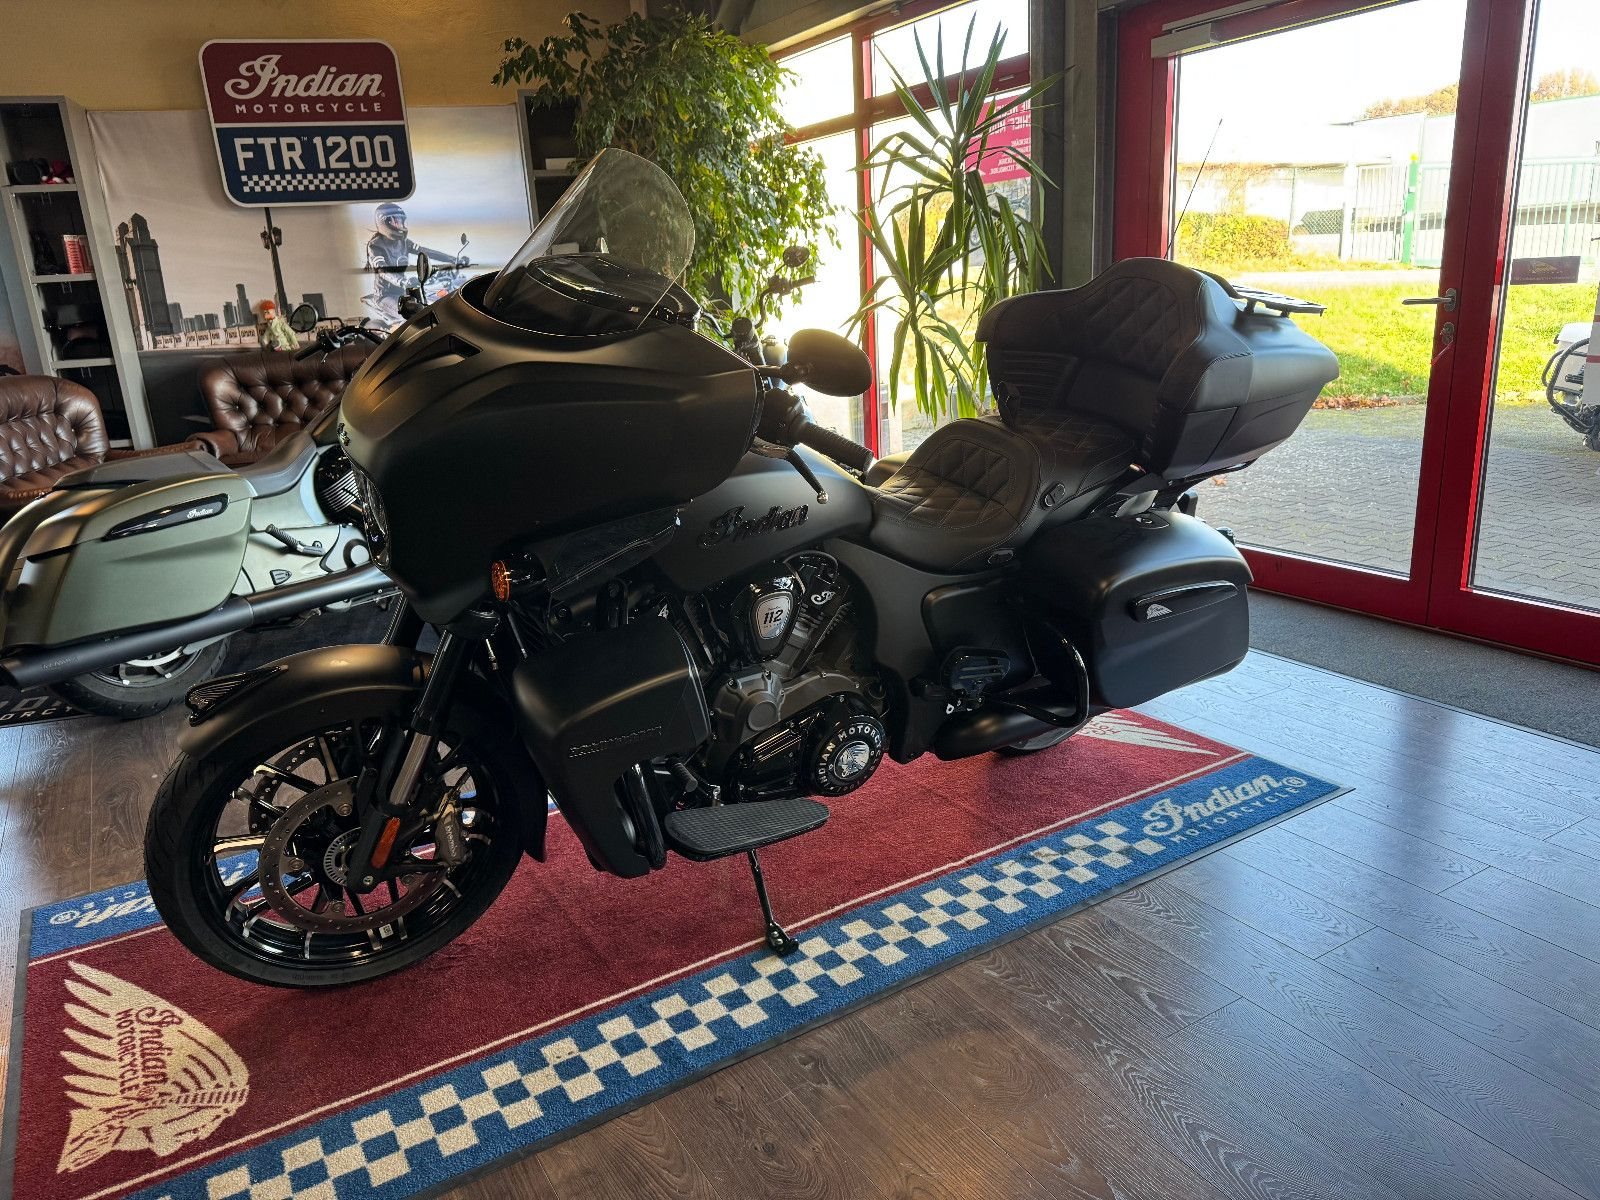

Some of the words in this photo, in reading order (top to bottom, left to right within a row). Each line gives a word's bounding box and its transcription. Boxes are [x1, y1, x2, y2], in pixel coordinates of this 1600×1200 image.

[224, 54, 383, 100] Indian
[235, 102, 382, 114] MOTORCYCLE
[313, 135, 396, 169] 1200
[698, 504, 808, 547] Indian
[764, 609, 784, 624] 112
[819, 742, 837, 788] INDIAN
[1142, 775, 1283, 837] Indian
[1169, 787, 1301, 844] MOTORCYCLE
[115, 1008, 140, 1096] MOTORCYCLE
[136, 1007, 183, 1088] Indian
